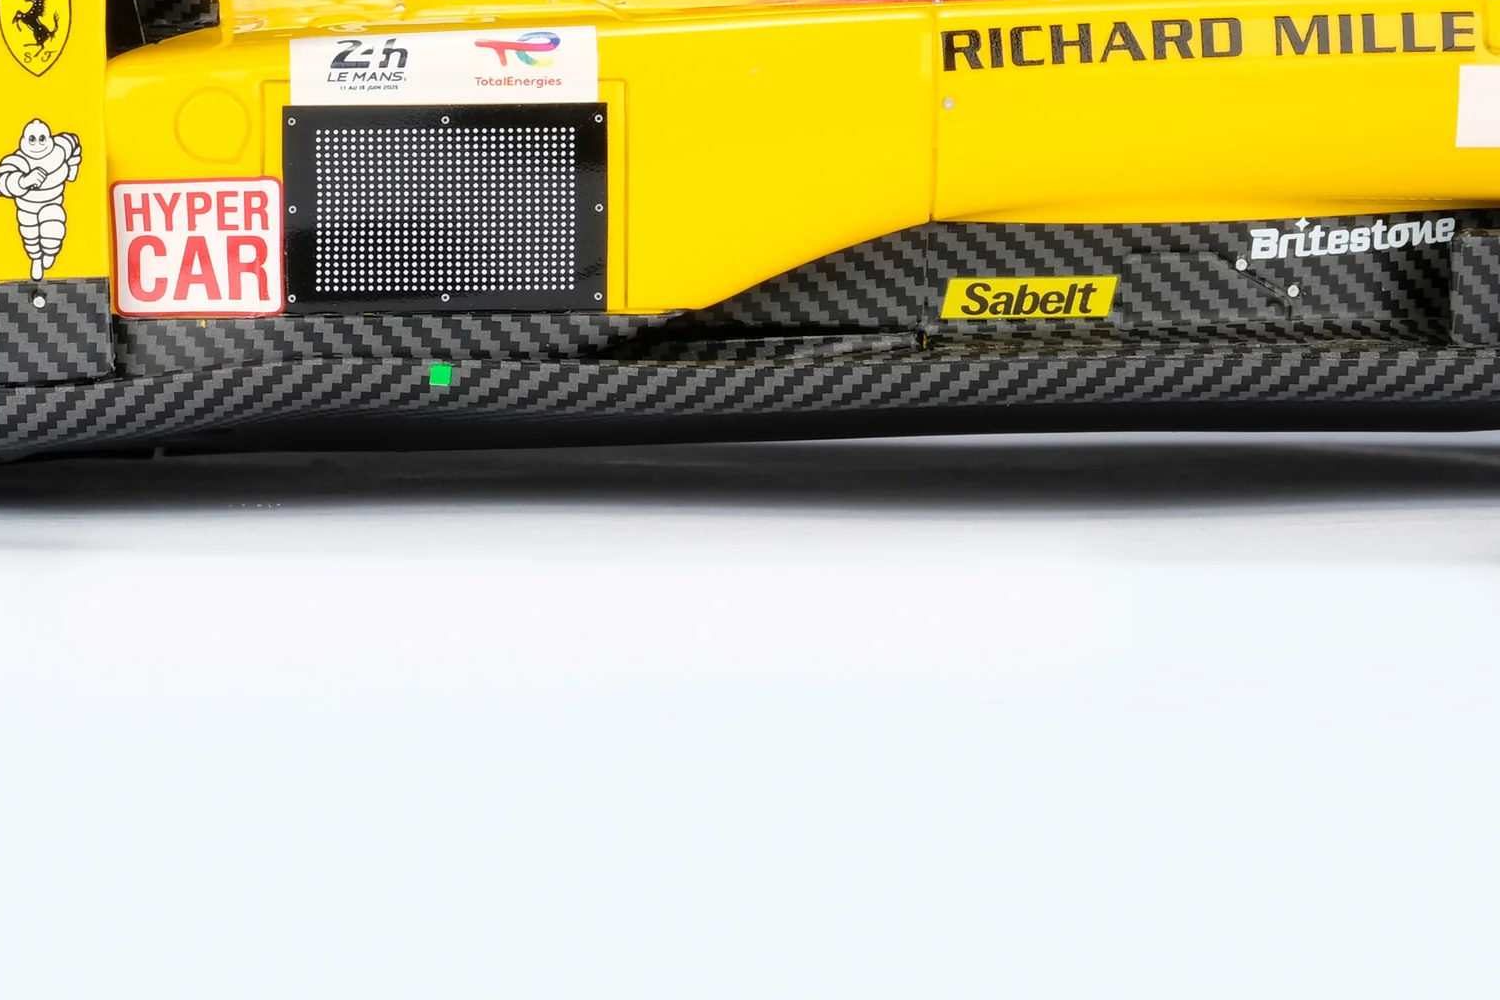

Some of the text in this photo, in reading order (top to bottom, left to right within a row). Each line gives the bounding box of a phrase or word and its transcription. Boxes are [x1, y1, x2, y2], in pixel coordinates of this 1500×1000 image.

[941, 11, 1476, 72] RICHARD MILLE
[327, 72, 349, 82] LE
[474, 76, 562, 88] TotalEnergies
[123, 190, 270, 232] HYPER
[1250, 217, 1456, 260] Britestone
[127, 234, 271, 302] CAR
[961, 282, 1098, 316] Sabelt
